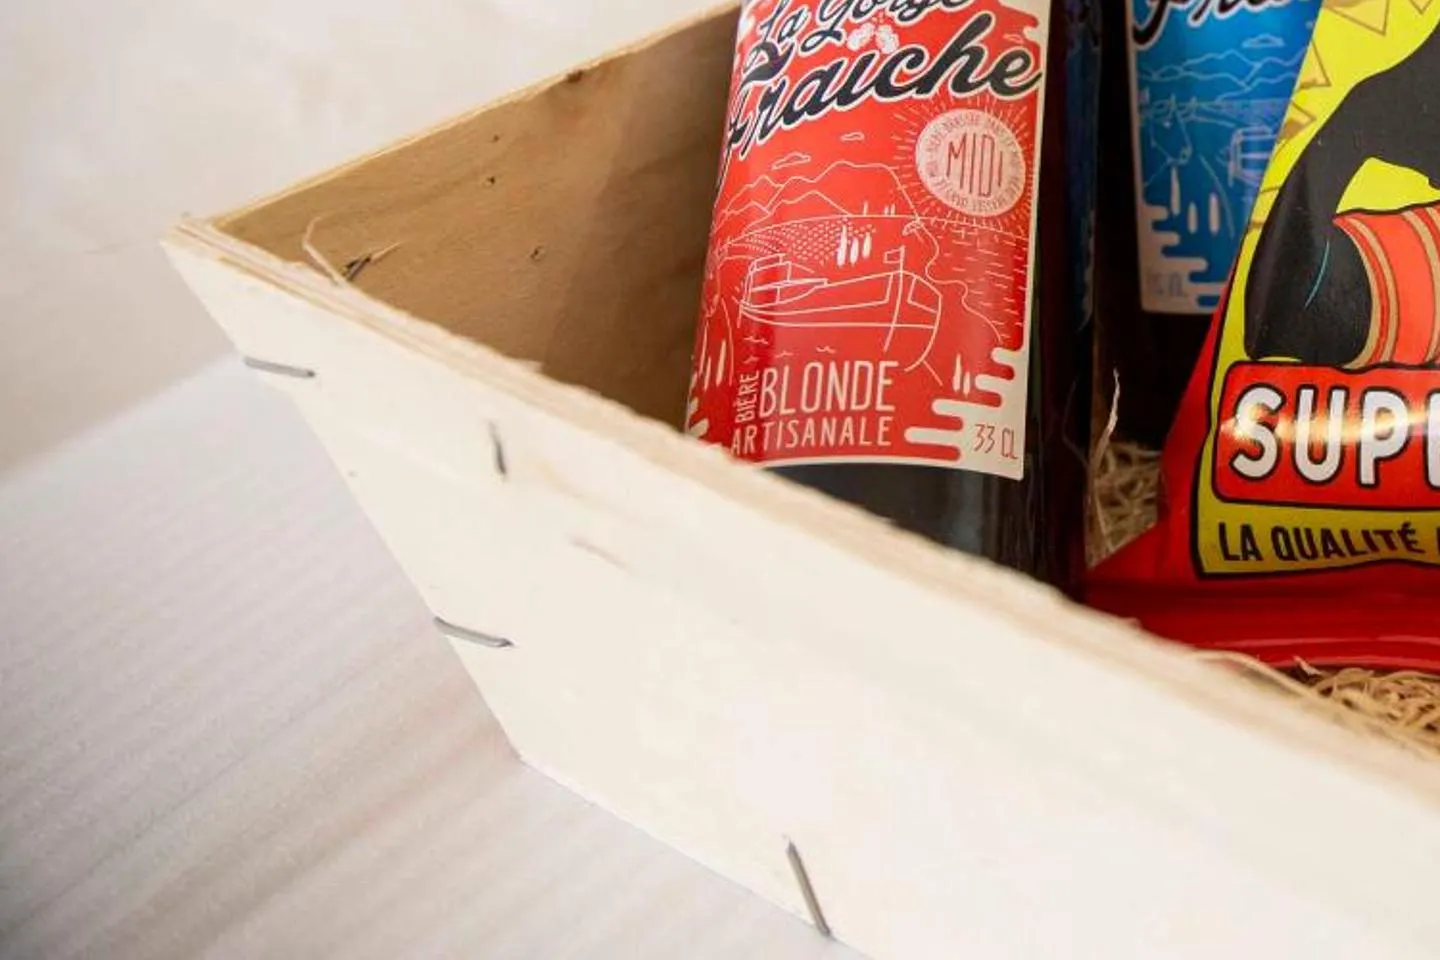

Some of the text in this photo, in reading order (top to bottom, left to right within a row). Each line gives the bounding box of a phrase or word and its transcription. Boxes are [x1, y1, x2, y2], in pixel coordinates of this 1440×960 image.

[945, 132, 1003, 197] MIDI
[759, 360, 899, 418] BLONDE
[730, 416, 893, 455] ARTISANALE
[973, 423, 1018, 460] 33 CL
[1218, 521, 1258, 563] LA
[1269, 521, 1424, 562] QUALITÉ
